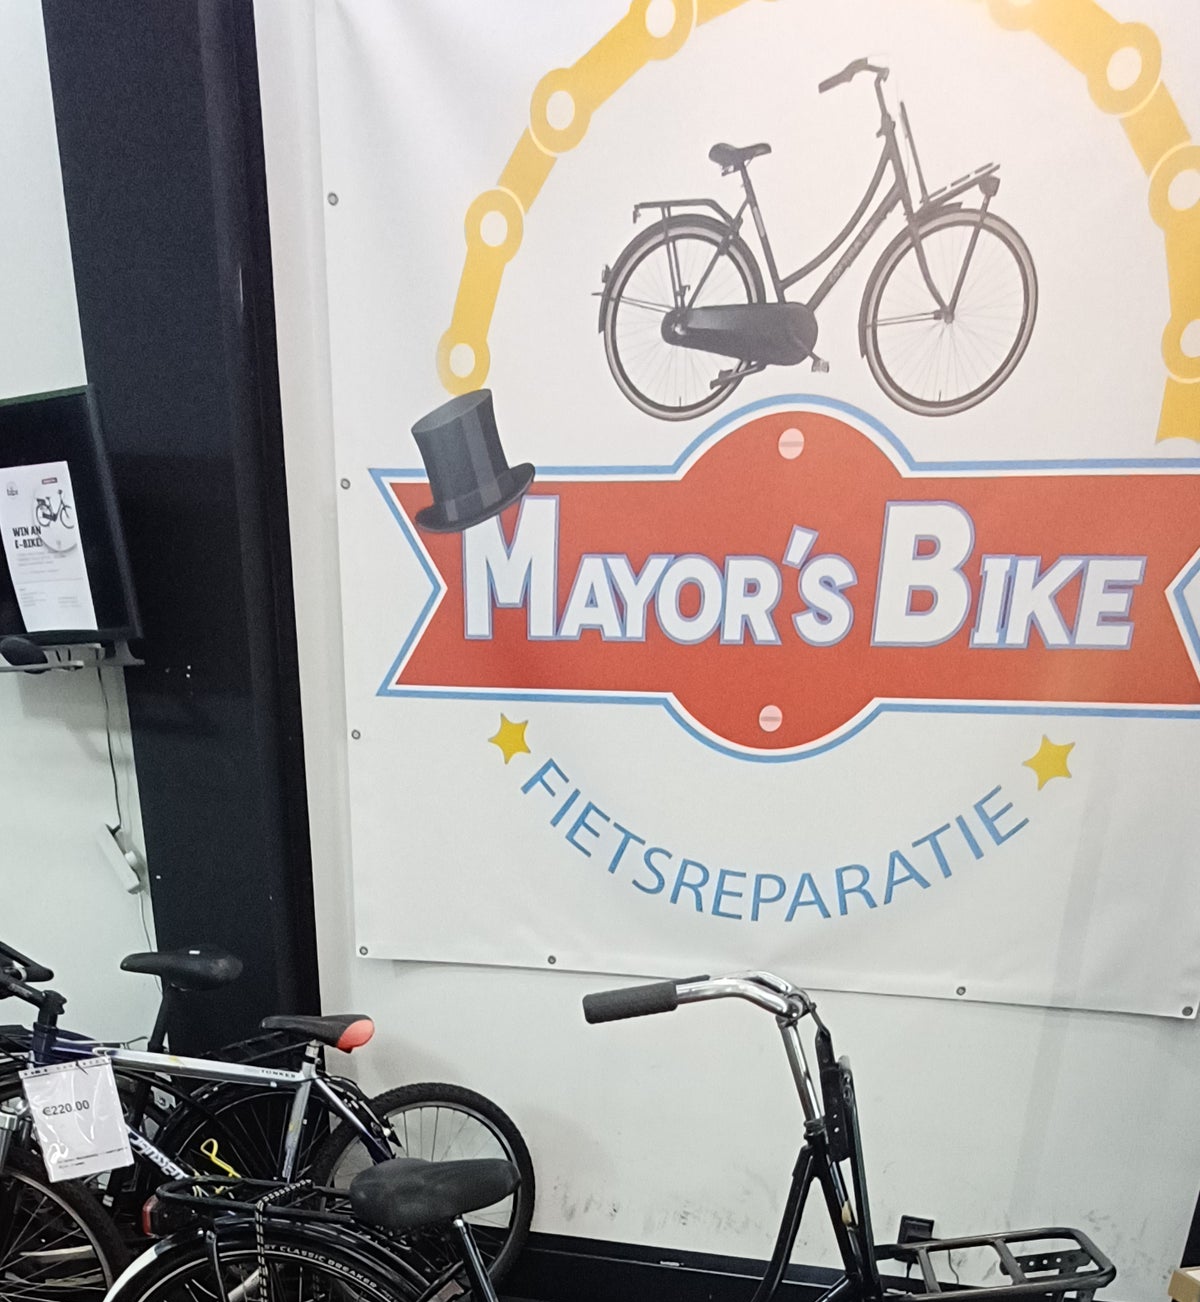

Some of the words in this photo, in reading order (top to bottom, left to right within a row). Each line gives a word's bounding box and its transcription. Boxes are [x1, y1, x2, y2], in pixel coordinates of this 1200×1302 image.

[12, 526, 29, 537] WIN
[31, 525, 42, 536] AN
[462, 495, 857, 647] MAYOR'S
[870, 500, 1147, 649] BIKE
[520, 758, 1030, 922] FIETSREPARATIE
[279, 1245, 327, 1263] CLASSIC
[327, 1259, 378, 1288] BREAKER
